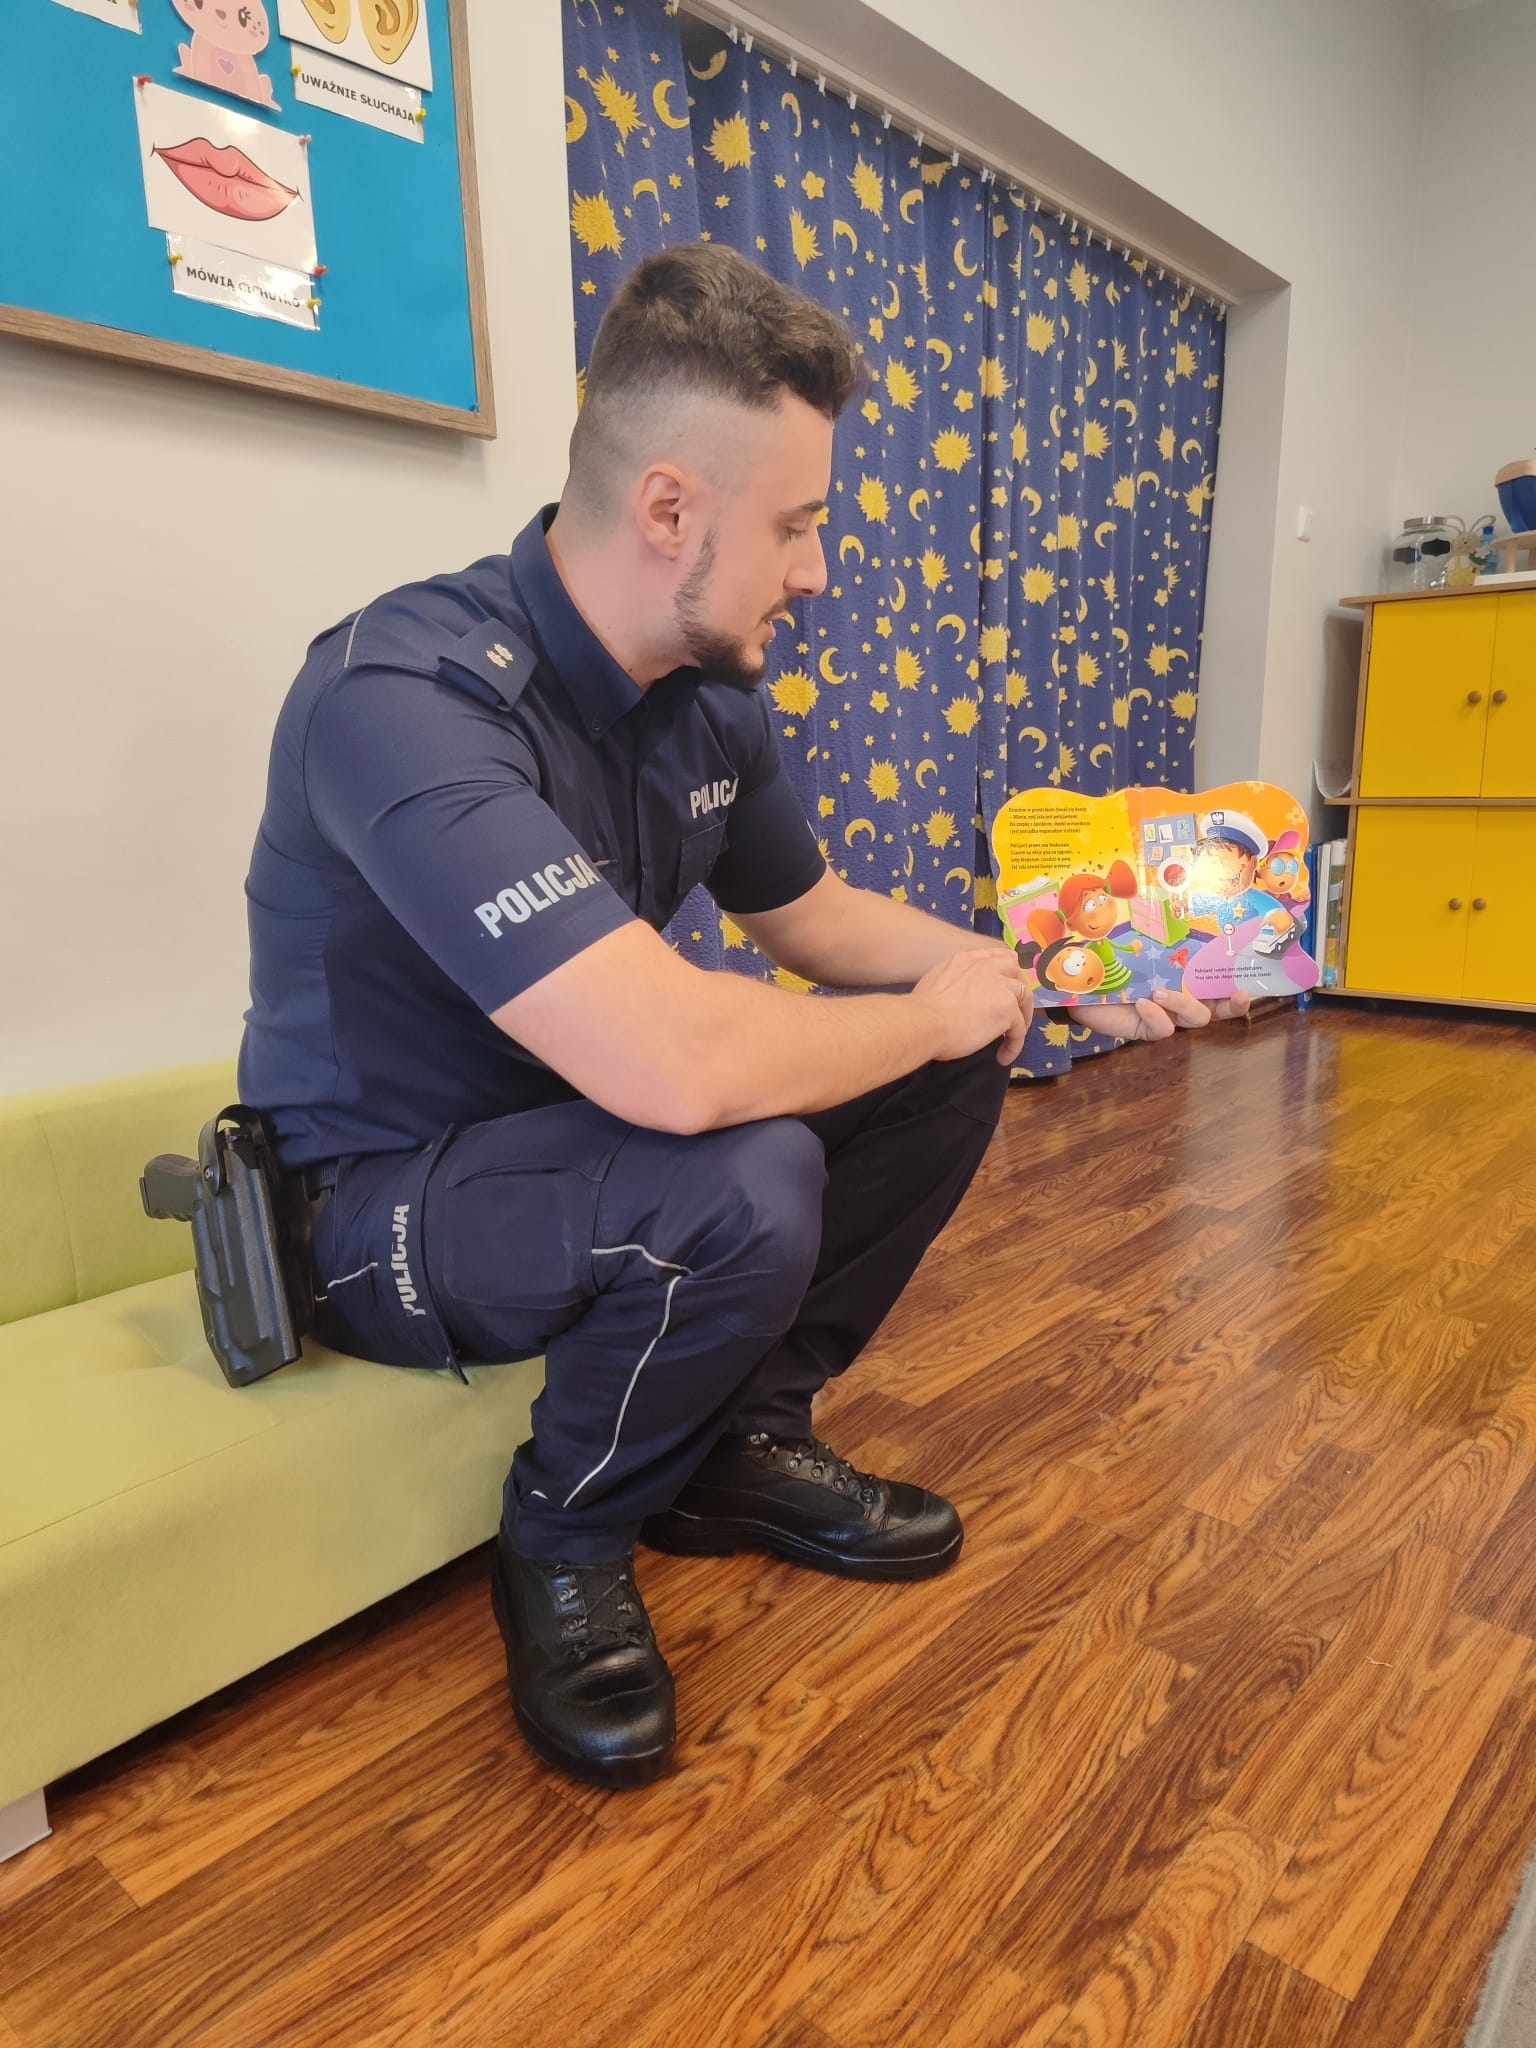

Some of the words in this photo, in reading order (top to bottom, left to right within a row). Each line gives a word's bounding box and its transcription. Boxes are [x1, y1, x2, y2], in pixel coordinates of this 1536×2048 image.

[301, 73, 358, 101] UWAŻNIE
[359, 94, 416, 125] SŁUCHAJĄ
[186, 264, 235, 292] MÓWIĄ
[689, 777, 740, 820] POLICJ
[473, 853, 602, 939] POLICJA
